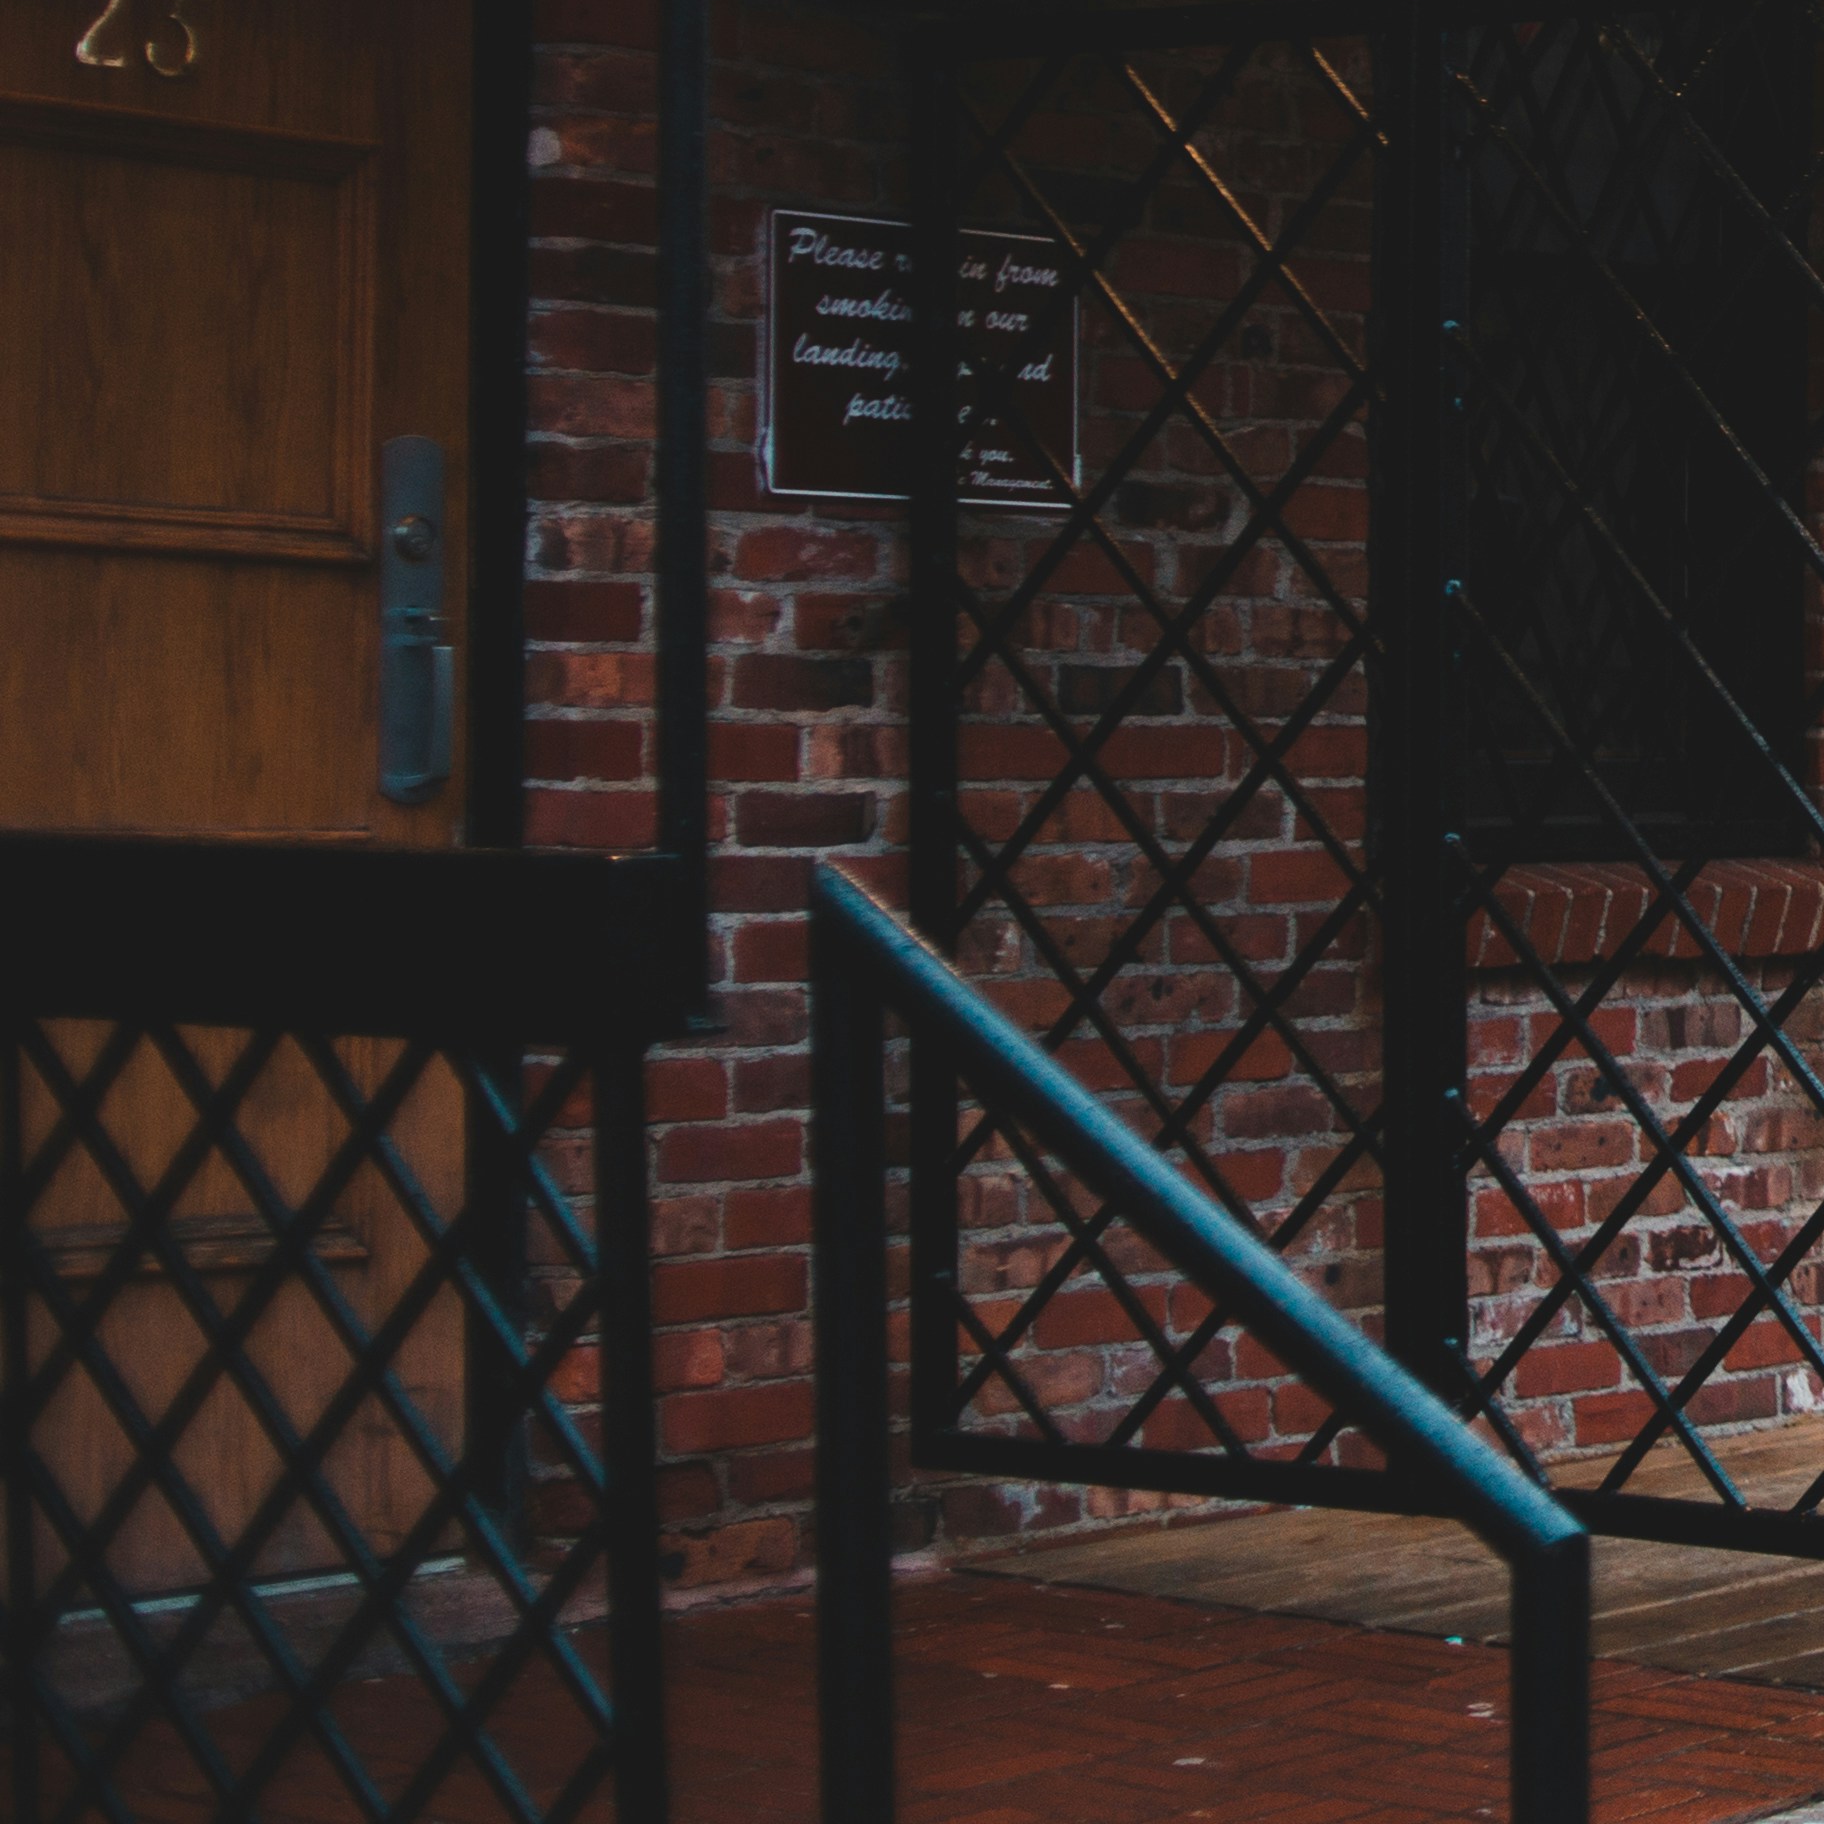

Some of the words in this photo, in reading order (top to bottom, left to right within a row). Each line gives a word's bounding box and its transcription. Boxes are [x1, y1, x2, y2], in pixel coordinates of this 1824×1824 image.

[788, 226, 885, 271] Please
[994, 253, 1060, 294] from
[985, 309, 1030, 332] our
